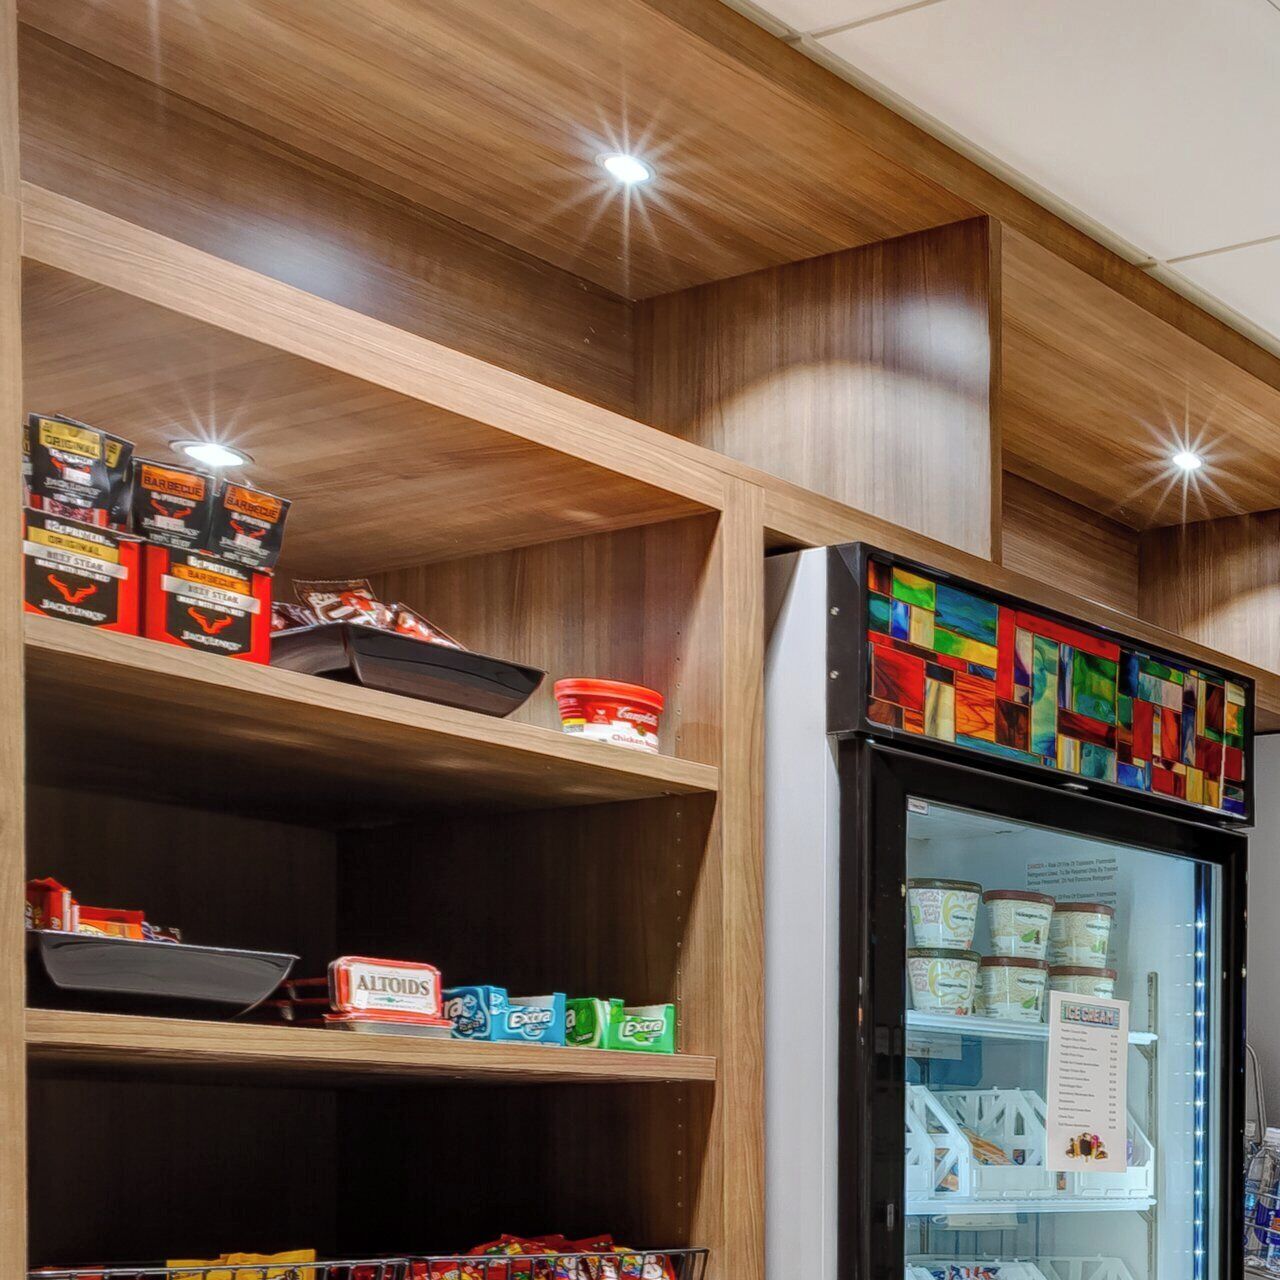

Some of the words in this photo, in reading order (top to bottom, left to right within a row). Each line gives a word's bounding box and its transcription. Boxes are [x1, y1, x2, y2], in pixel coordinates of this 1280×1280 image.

[44, 434, 99, 458] ORIGINAL
[143, 474, 203, 497] BARBECUE
[226, 495, 278, 520] BARBECUE
[47, 534, 102, 557] ORIGINAL
[46, 550, 72, 567] BEEF
[72, 556, 104, 573] STEAK
[187, 569, 237, 590] BARBECUE
[187, 584, 210, 599] BEEF
[210, 589, 239, 604] STEAK
[611, 733, 646, 746] Chicken
[356, 974, 431, 997] ALTOIDS
[508, 1009, 551, 1027] Extra
[1064, 1005, 1080, 1022] ICE
[1081, 1008, 1114, 1026] CREAM
[623, 1019, 664, 1036] Extra
